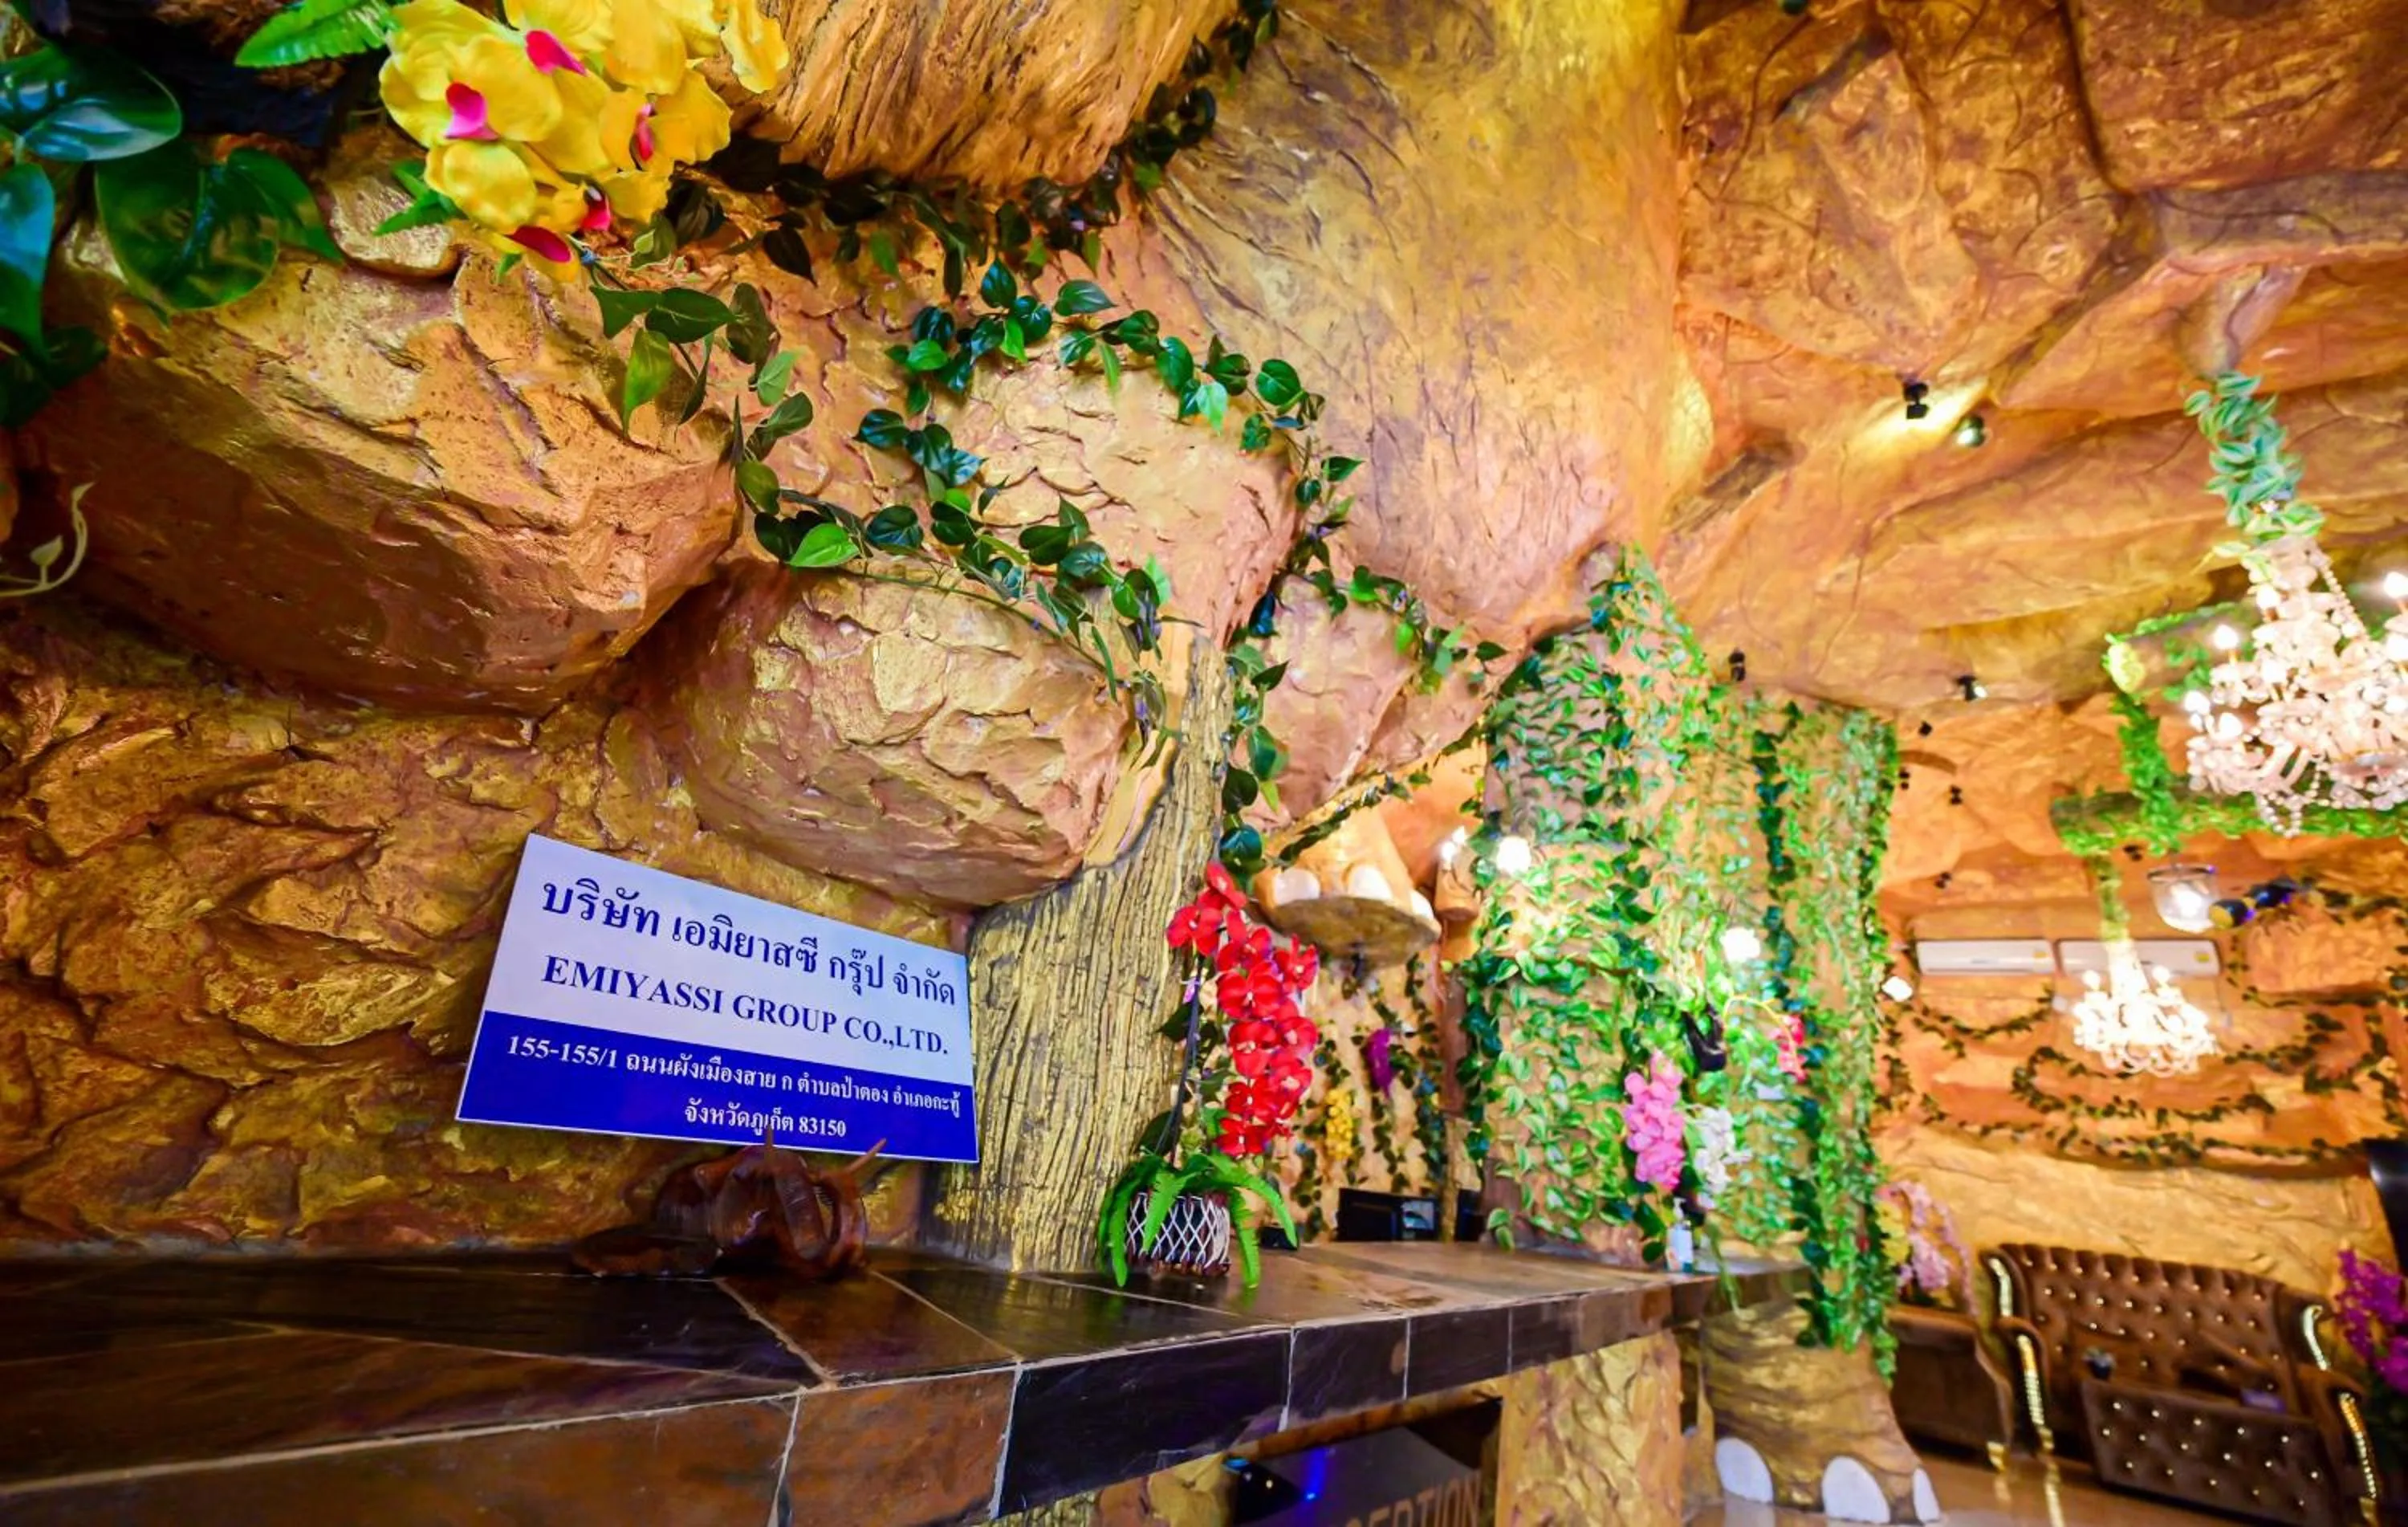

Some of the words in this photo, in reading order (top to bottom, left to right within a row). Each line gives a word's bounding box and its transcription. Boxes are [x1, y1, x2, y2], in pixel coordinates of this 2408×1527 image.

[542, 878, 661, 937] บริษัท
[672, 914, 819, 974] เอมิยาสซี
[829, 947, 885, 996] กรุ๊ป
[893, 963, 956, 1006] จำกัด
[541, 955, 724, 1014] EMIYASSI
[732, 994, 837, 1035] GROUP
[844, 1016, 949, 1055] CO.,LTD.
[506, 1035, 618, 1069] 155-155/1
[625, 1052, 777, 1089] ถนนผังเมืองสาย
[797, 1072, 889, 1104] ตำบลป่าตอง
[892, 1085, 961, 1118] อำเภอกะทู้
[684, 1097, 795, 1137] จังหวัดภูเก็ต
[798, 1115, 847, 1138] 83150
